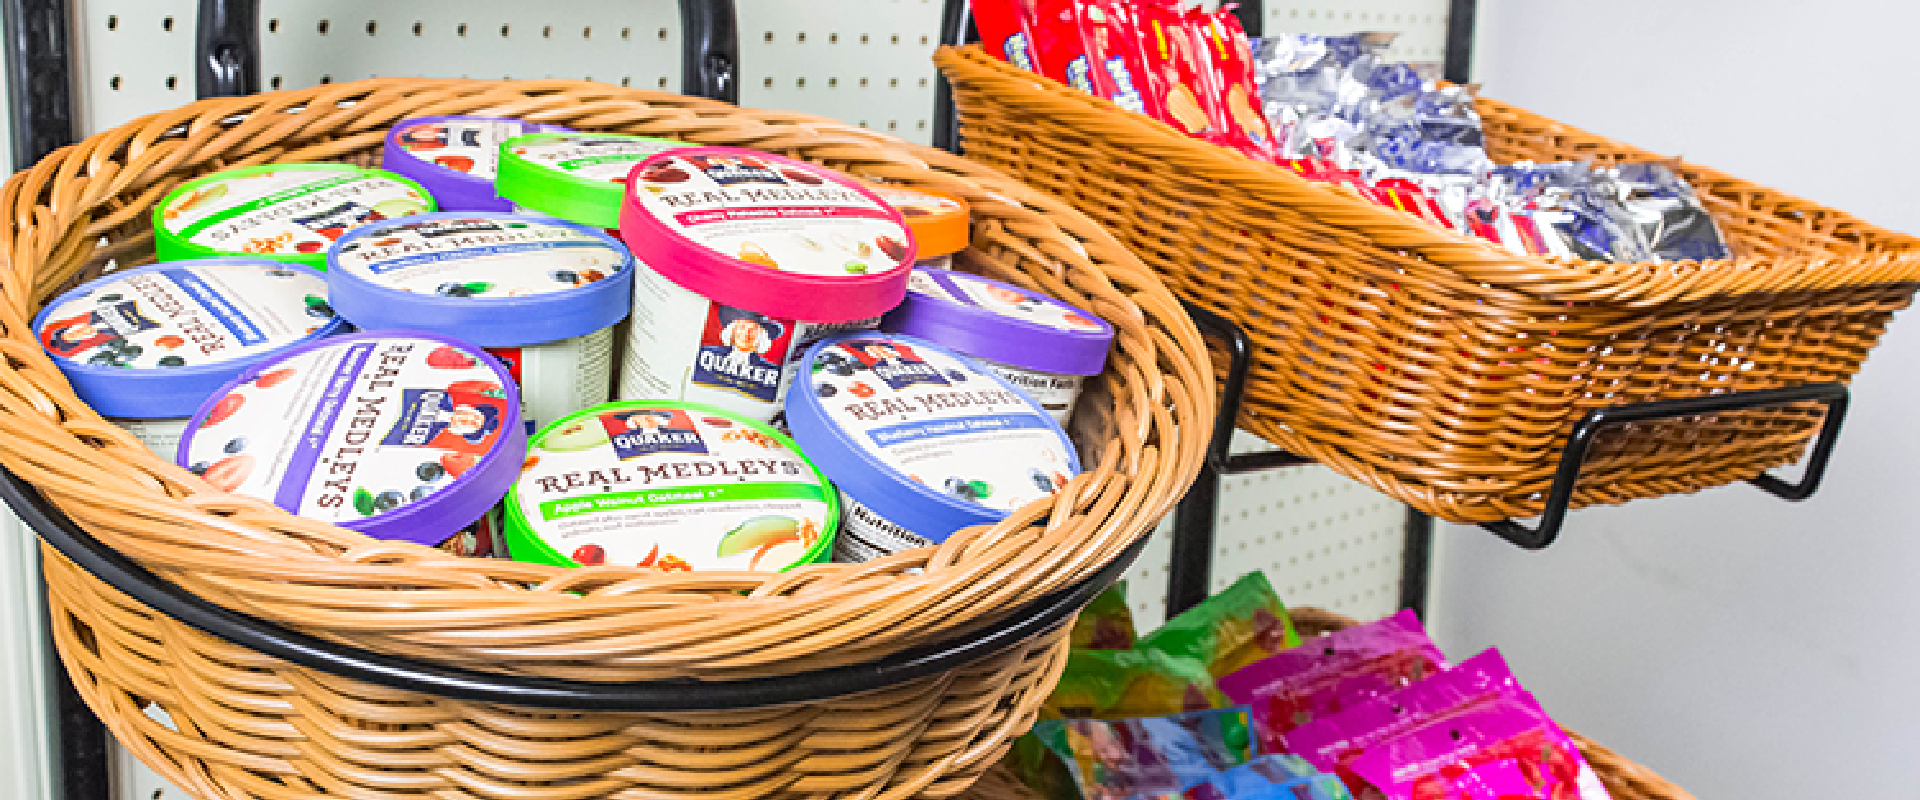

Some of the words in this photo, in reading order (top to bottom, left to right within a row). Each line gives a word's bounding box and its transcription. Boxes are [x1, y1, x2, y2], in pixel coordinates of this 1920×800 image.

[659, 190, 740, 208] REAL
[740, 188, 869, 204] MEDLEYS
[357, 241, 441, 261] REAL
[368, 343, 414, 391] REAL
[700, 351, 780, 386] QUAKER
[403, 390, 445, 446] QUAKER
[844, 396, 917, 421] REAL
[914, 389, 1022, 412] MEDLEYS
[316, 396, 387, 509] MEDLEYS
[613, 431, 702, 449] QUAKER
[535, 467, 632, 493] REAL
[637, 460, 801, 485] MEDLEYS
[554, 499, 593, 515] Apple
[597, 493, 645, 508] Walnut
[647, 489, 704, 503] Oatmeal
[854, 505, 926, 547] Nutrition
